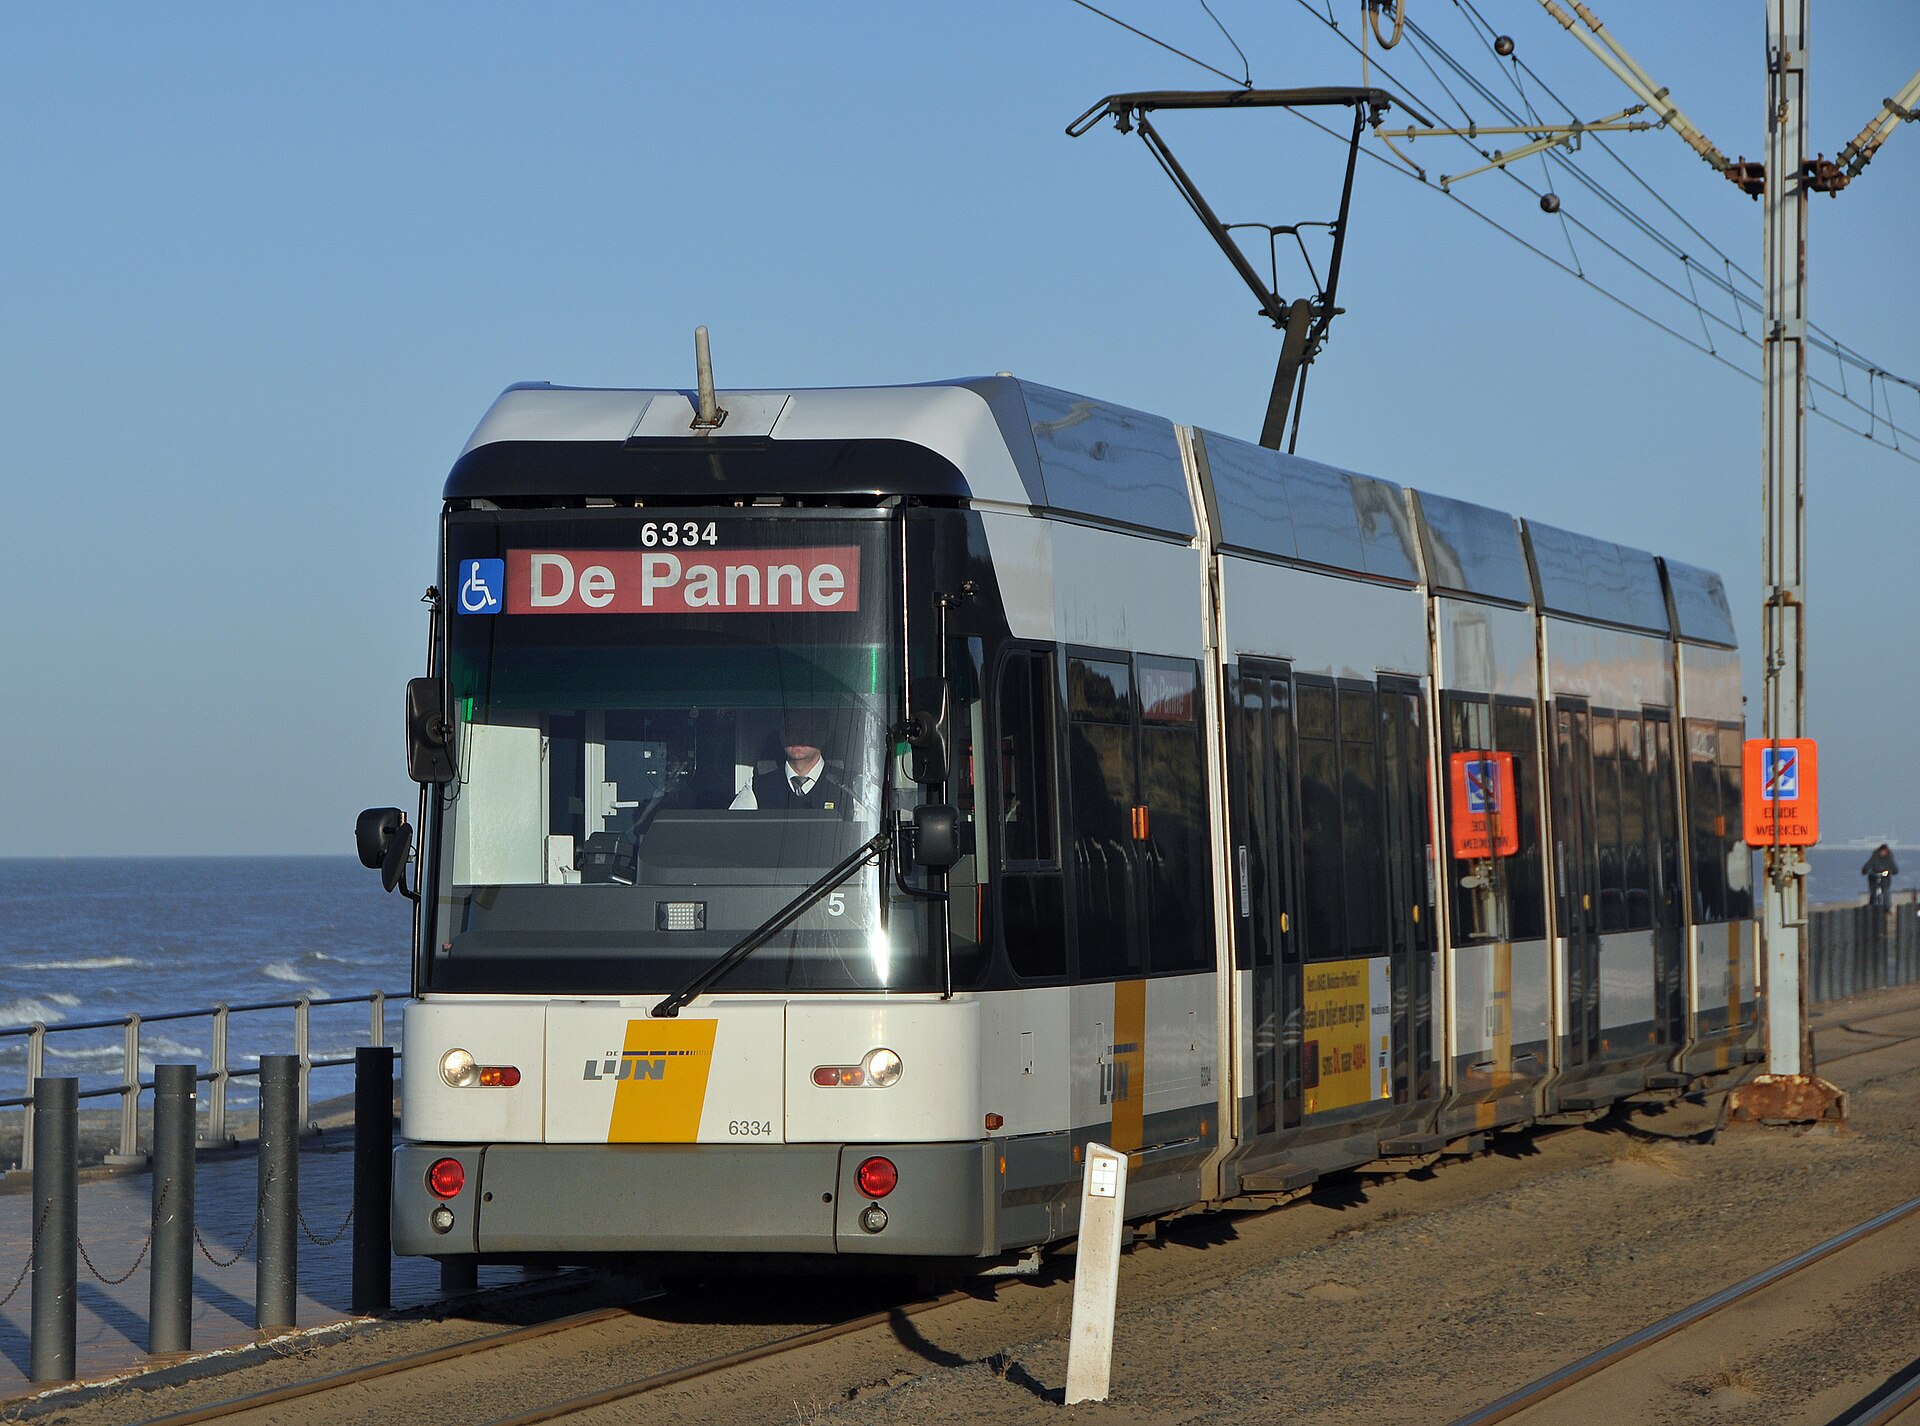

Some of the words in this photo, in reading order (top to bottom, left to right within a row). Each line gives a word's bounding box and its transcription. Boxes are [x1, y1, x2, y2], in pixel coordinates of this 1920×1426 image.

[641, 521, 718, 546] 6334
[529, 553, 615, 607] De
[641, 552, 845, 607] Panne
[827, 892, 845, 917] 5
[728, 1120, 772, 1136] 6334
